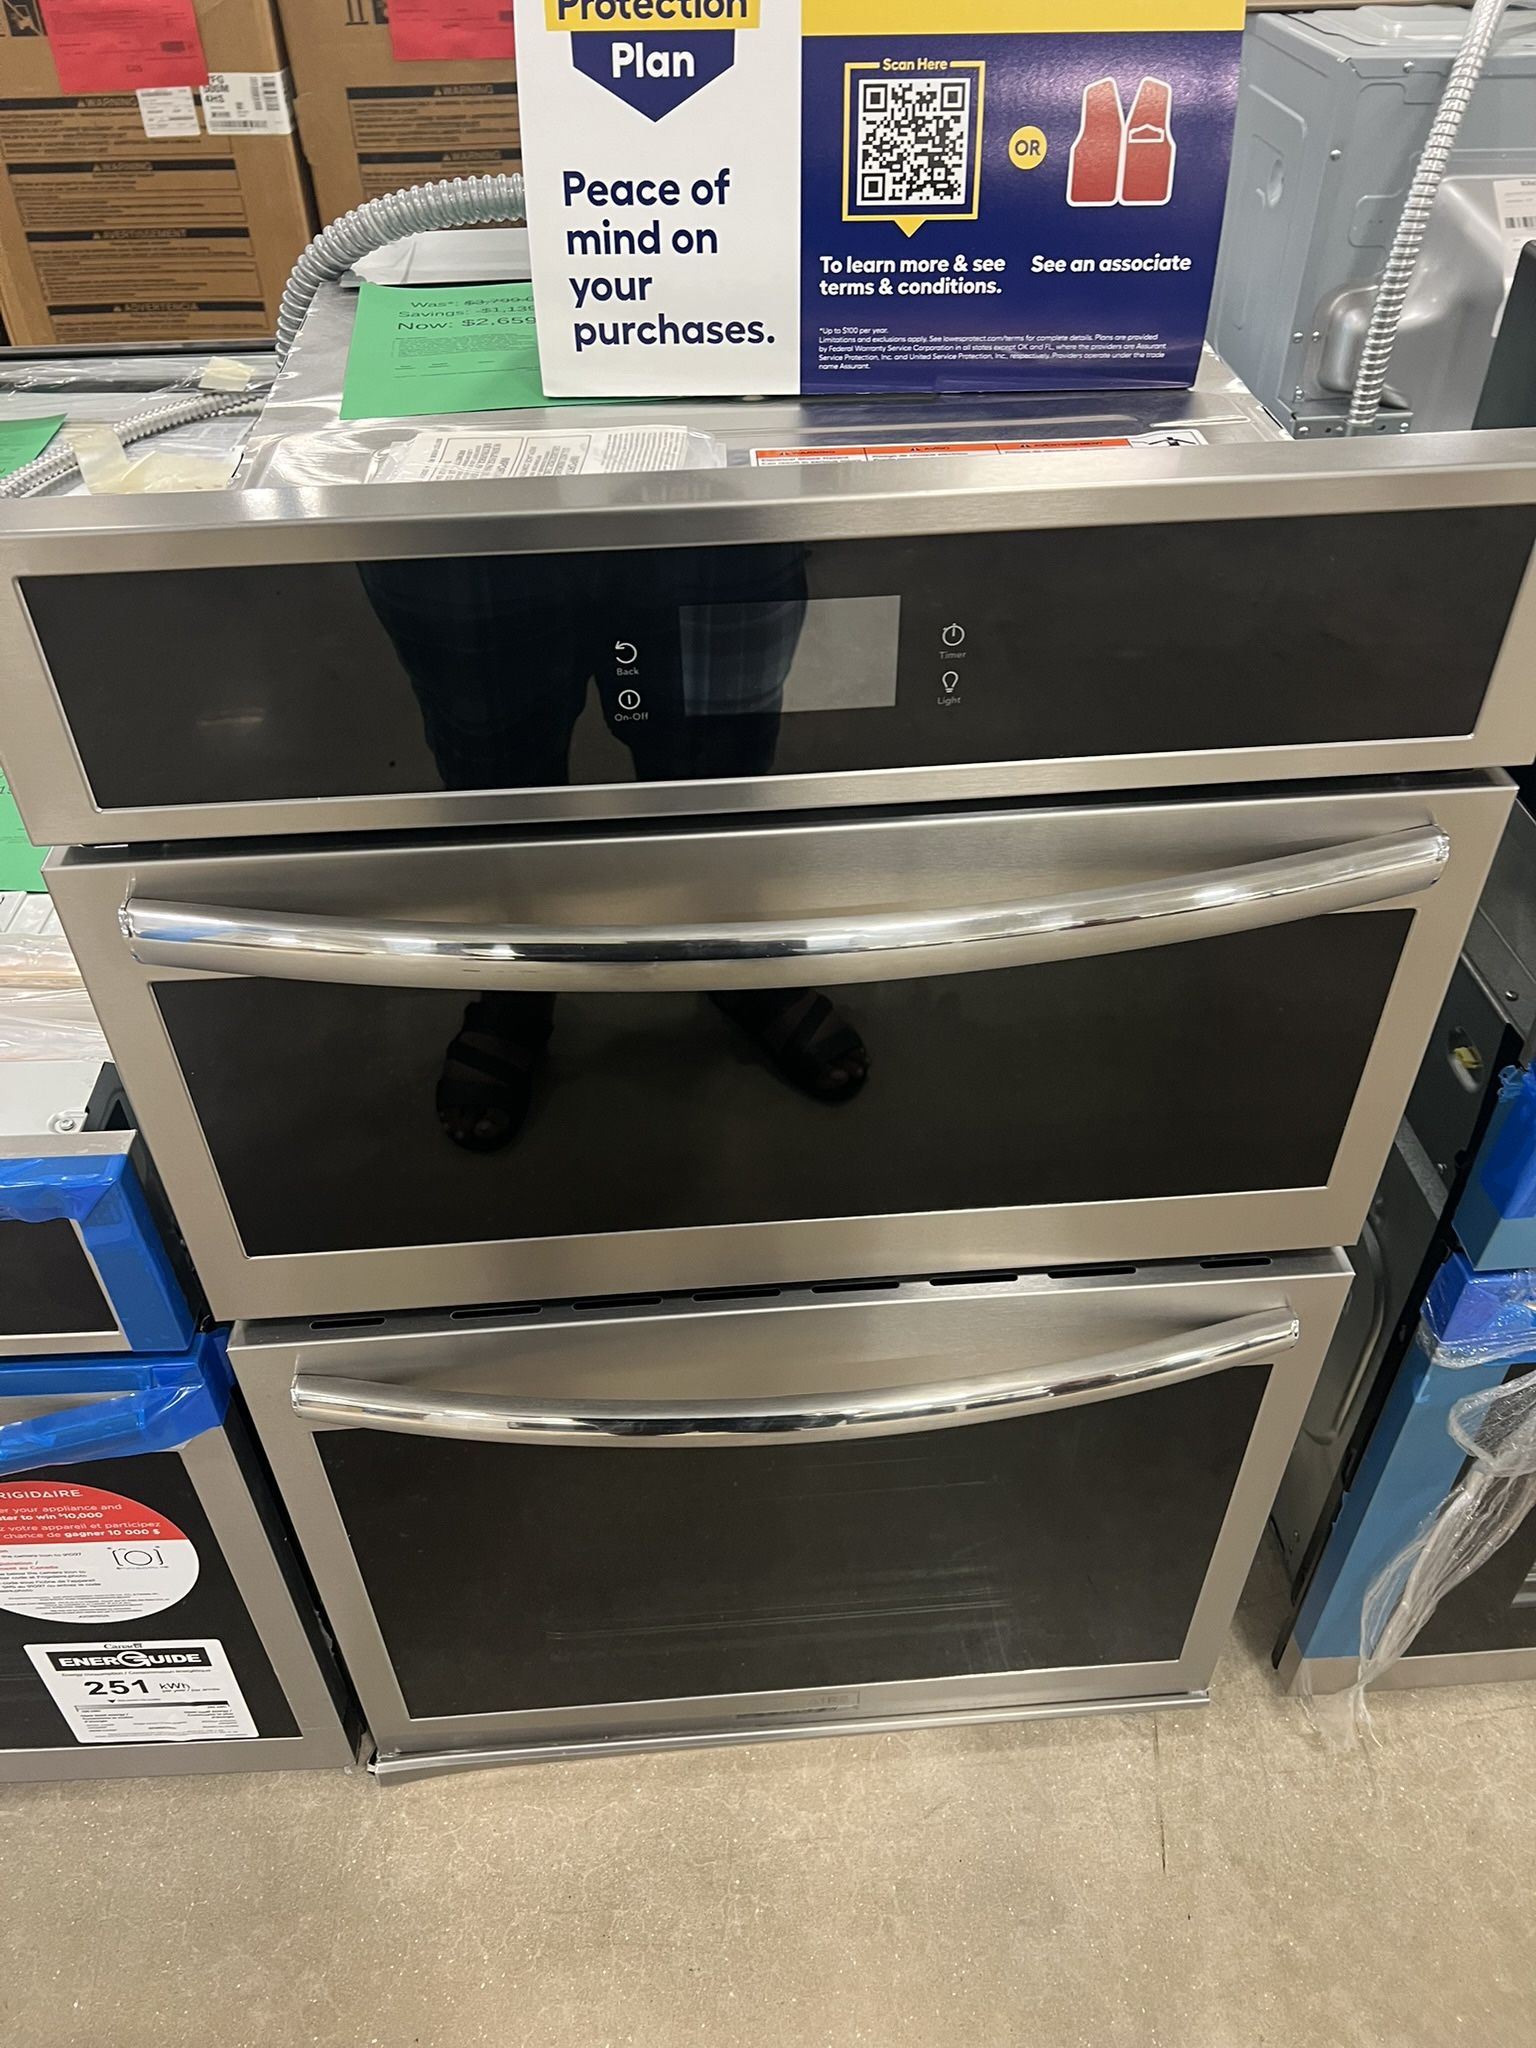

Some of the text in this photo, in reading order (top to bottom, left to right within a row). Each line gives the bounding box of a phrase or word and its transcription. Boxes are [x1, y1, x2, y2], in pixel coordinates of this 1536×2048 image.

[558, 0, 748, 20] Protection
[611, 42, 695, 78] Plan
[882, 58, 948, 71] Scan Here
[1015, 139, 1041, 156] OR
[563, 168, 730, 206] Peace of
[567, 219, 718, 255] mind on
[820, 254, 1006, 273] To learn more & see
[1031, 253, 1192, 273] See an associate
[569, 277, 652, 308] your
[819, 277, 1002, 296] terms & conditions.
[399, 310, 470, 318] Savings:
[398, 322, 453, 330] Now:
[574, 313, 775, 352] purchases.
[1036, 334, 1068, 342] complete
[1127, 333, 1159, 341] provided
[855, 345, 886, 353] Warranty
[912, 344, 954, 352] Corporation
[939, 651, 966, 659] Timer
[616, 667, 639, 676] Back
[937, 697, 961, 706] Light
[614, 712, 649, 721] On-Off
[42, 1505, 97, 1513] appliance
[41, 1523, 87, 1531] appareil
[105, 1521, 160, 1529] participez
[64, 1531, 105, 1539] gagner
[84, 1679, 150, 1695] 251
